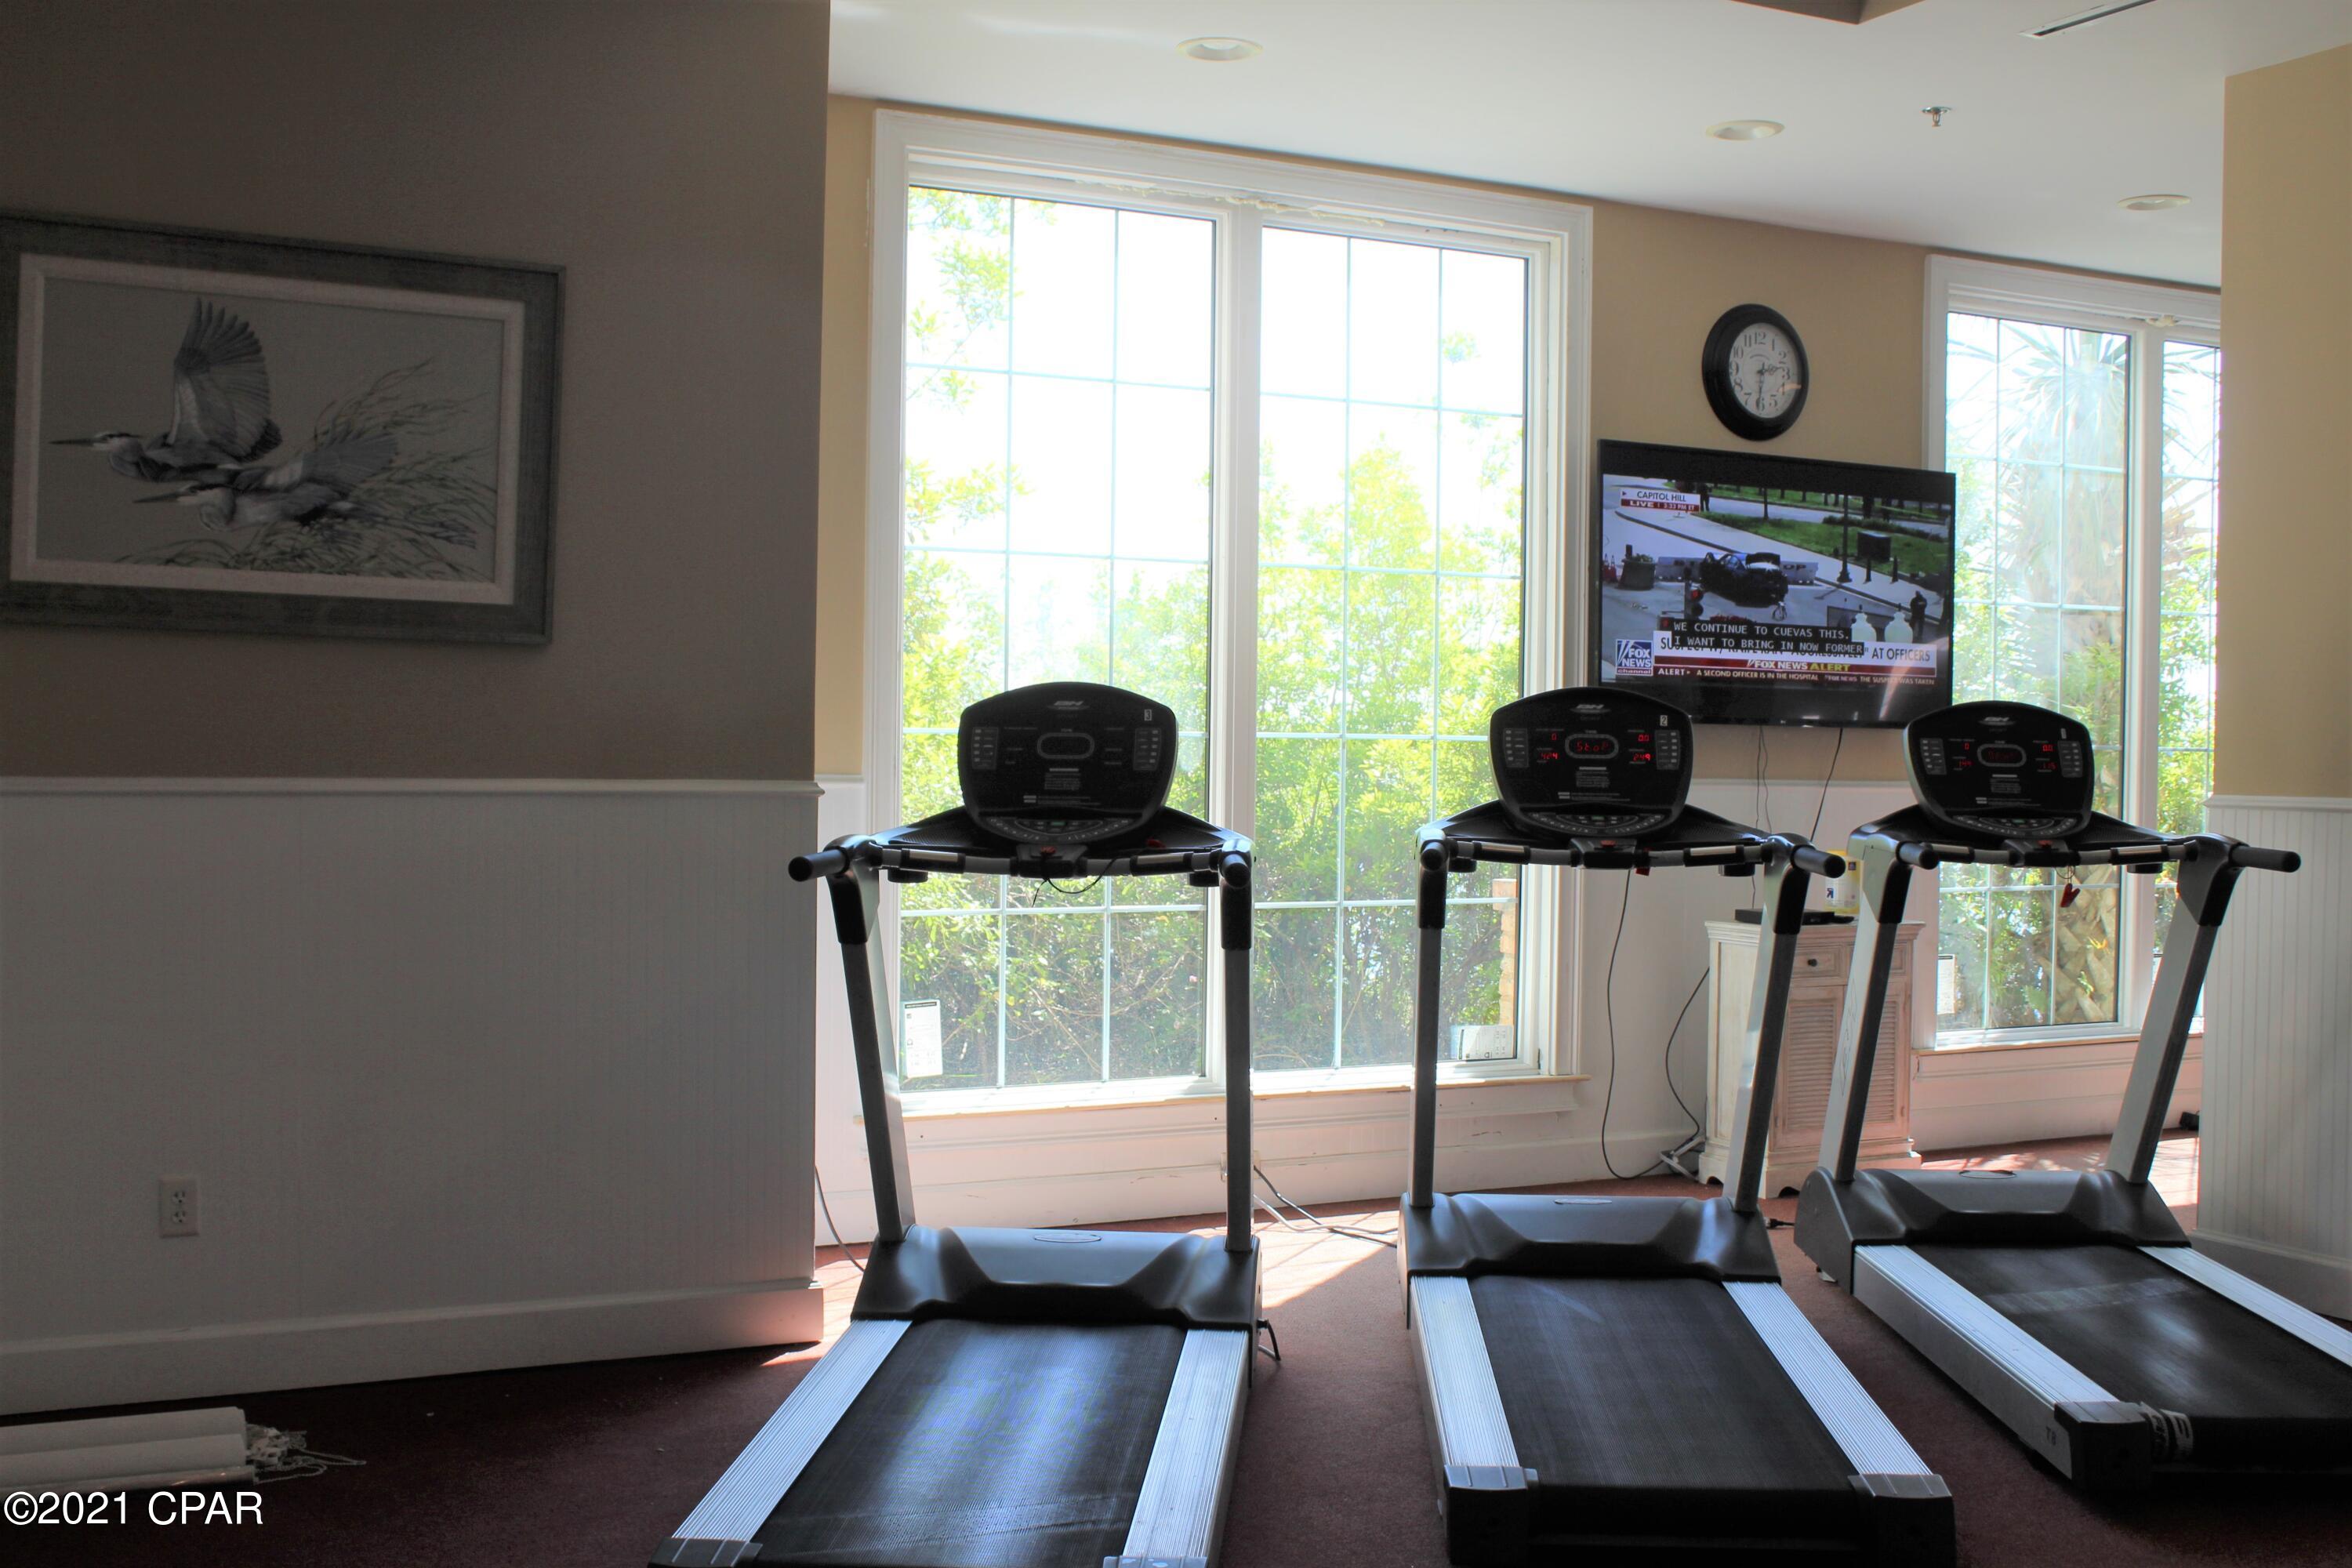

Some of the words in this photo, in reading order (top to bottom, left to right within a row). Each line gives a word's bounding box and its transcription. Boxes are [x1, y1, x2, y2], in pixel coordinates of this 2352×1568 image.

[1744, 334, 1752, 347] 11
[1754, 332, 1766, 345] 12
[1733, 345, 1744, 359] 10
[1778, 350, 1787, 365] 2
[1730, 360, 1739, 376] 9
[1733, 377, 1744, 391] 8
[1744, 392, 1752, 406] 7
[1769, 394, 1778, 408] 5
[1637, 490, 1669, 501] CAPITOL
[1671, 493, 1686, 502] HILL
[1674, 622, 1687, 631] WE
[1694, 622, 1748, 634] CONTINUE
[1755, 626, 1768, 635] TO
[1773, 627, 1813, 637] CUEVAS
[1819, 629, 1849, 640] THIS.
[1675, 636, 1681, 644] I
[1687, 637, 1715, 647] WANT
[1721, 638, 1735, 648] TO
[1741, 639, 1774, 649] BRING
[1780, 641, 1794, 651] IN
[1799, 643, 1819, 652] NOW
[1825, 643, 1863, 653] FORMER
[1628, 648, 1650, 659] FOX
[1871, 648, 1885, 659] AT
[1886, 648, 1931, 662] OFFICERS
[1621, 658, 1652, 667] NEWS
[1755, 660, 1776, 669] FOX
[1777, 661, 1808, 670] NEWS
[1809, 662, 1851, 672] ALERT
[1661, 715, 1668, 726] 2
